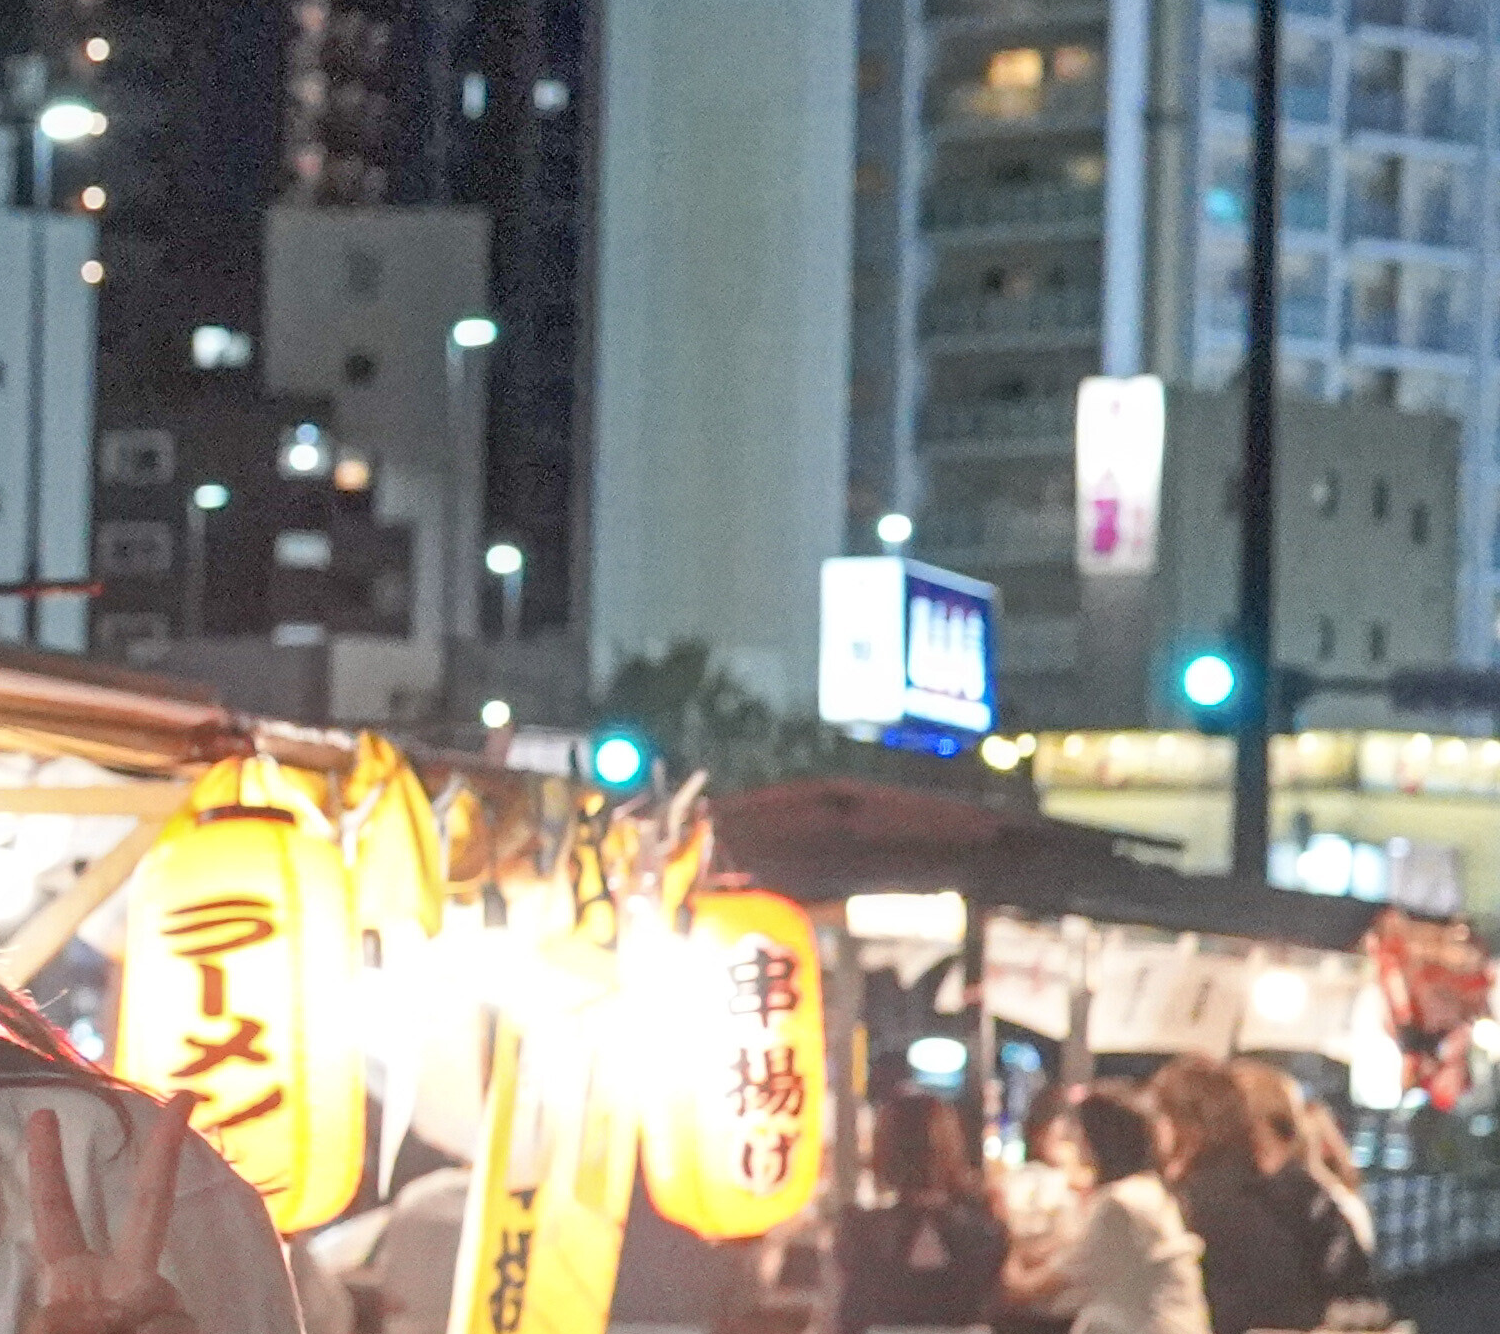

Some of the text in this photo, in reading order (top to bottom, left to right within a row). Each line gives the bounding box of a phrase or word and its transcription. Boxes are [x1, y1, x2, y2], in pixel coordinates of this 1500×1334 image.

[162, 898, 283, 1131] ラーメン
[726, 947, 804, 1186] 串揚げ
